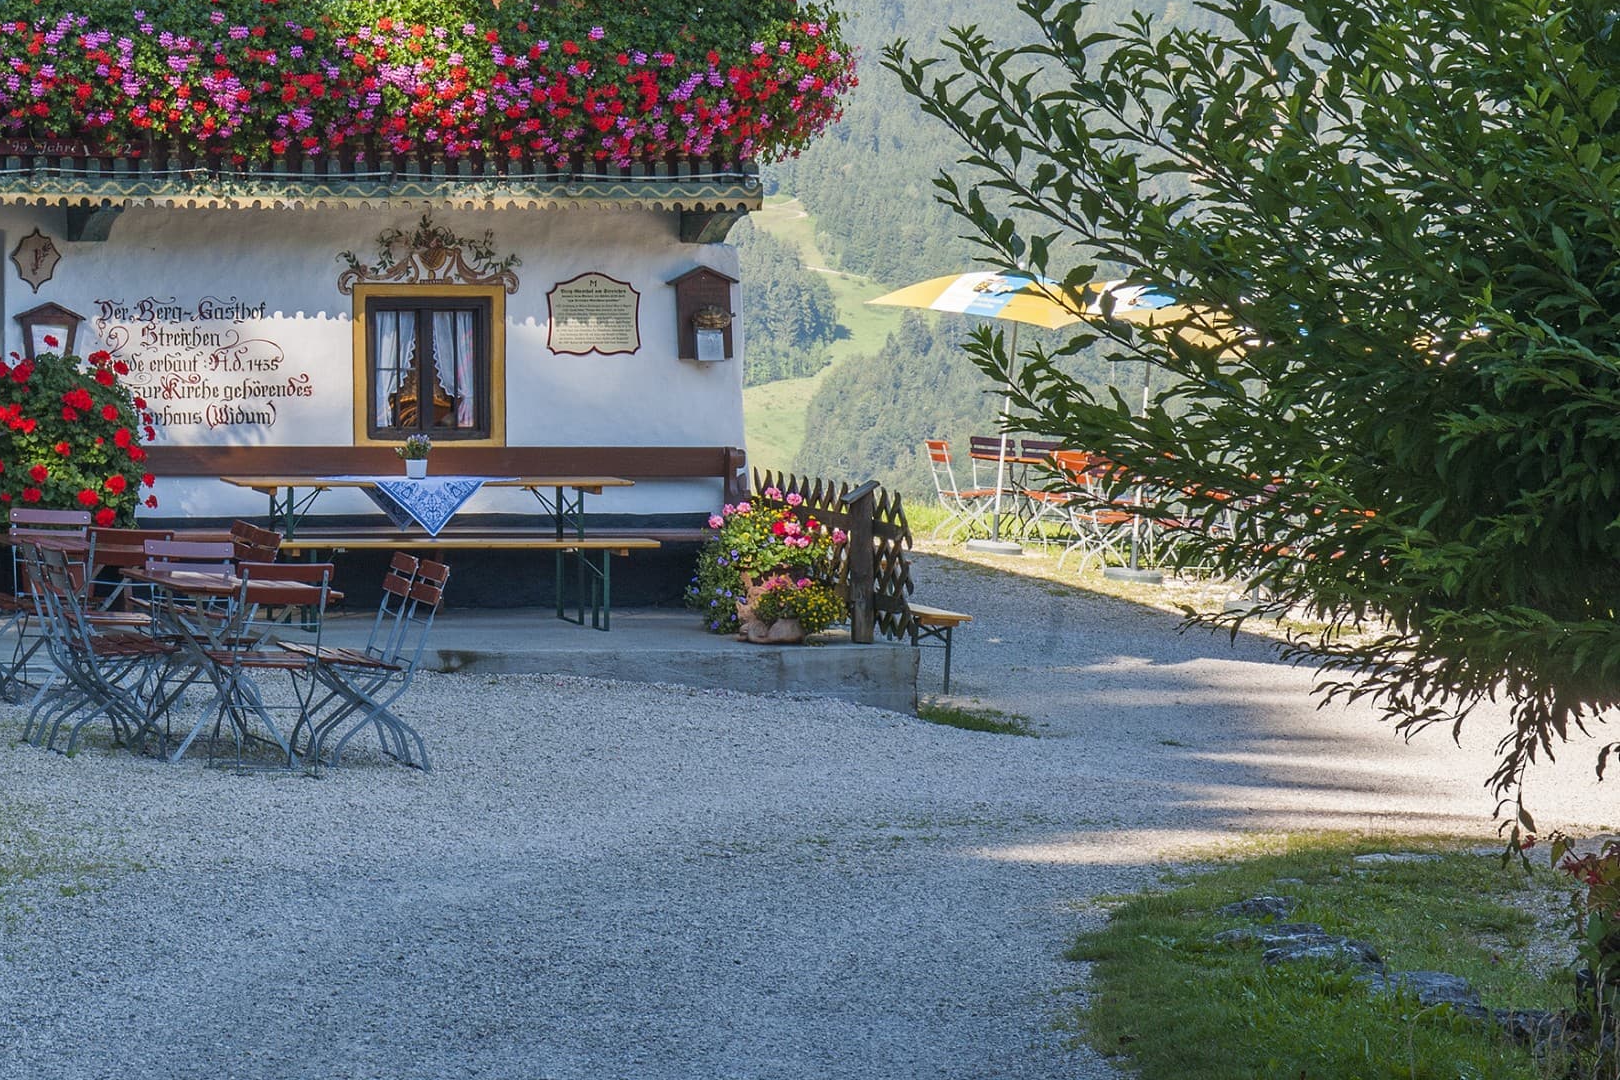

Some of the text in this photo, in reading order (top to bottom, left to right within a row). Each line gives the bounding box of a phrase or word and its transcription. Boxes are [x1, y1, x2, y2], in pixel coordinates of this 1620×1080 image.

[94, 298, 129, 322] Der
[140, 321, 222, 351] Streichen
[160, 373, 219, 401] Kirche
[223, 374, 312, 402] gehörendes
[206, 400, 277, 430] (Widum)
